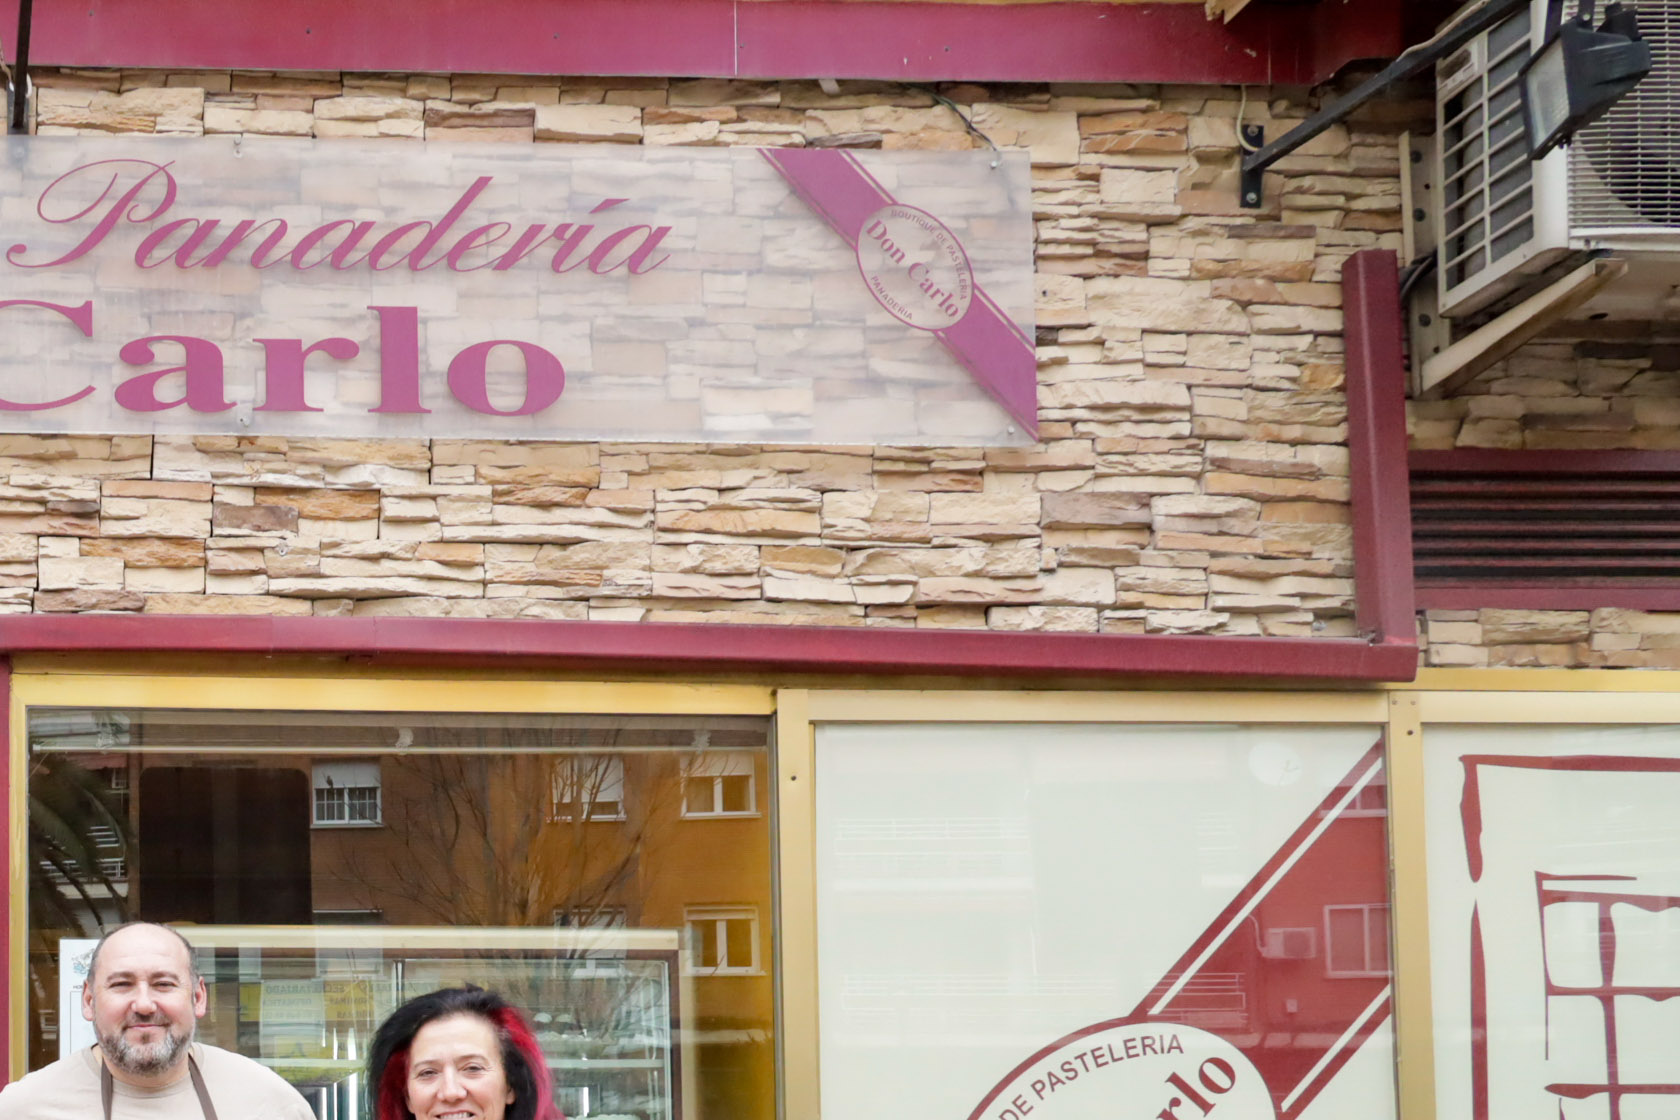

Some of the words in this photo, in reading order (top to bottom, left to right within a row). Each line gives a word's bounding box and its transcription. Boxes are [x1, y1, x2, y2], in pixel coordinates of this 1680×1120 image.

[5, 158, 673, 275] Panadería
[890, 209, 937, 234] BOUTIQUE
[935, 232, 949, 246] DE
[866, 220, 905, 264] Don
[908, 262, 959, 318] Carlo
[870, 275, 913, 320] PANADERIA
[1030, 1034, 1184, 1100] PASTELERIA
